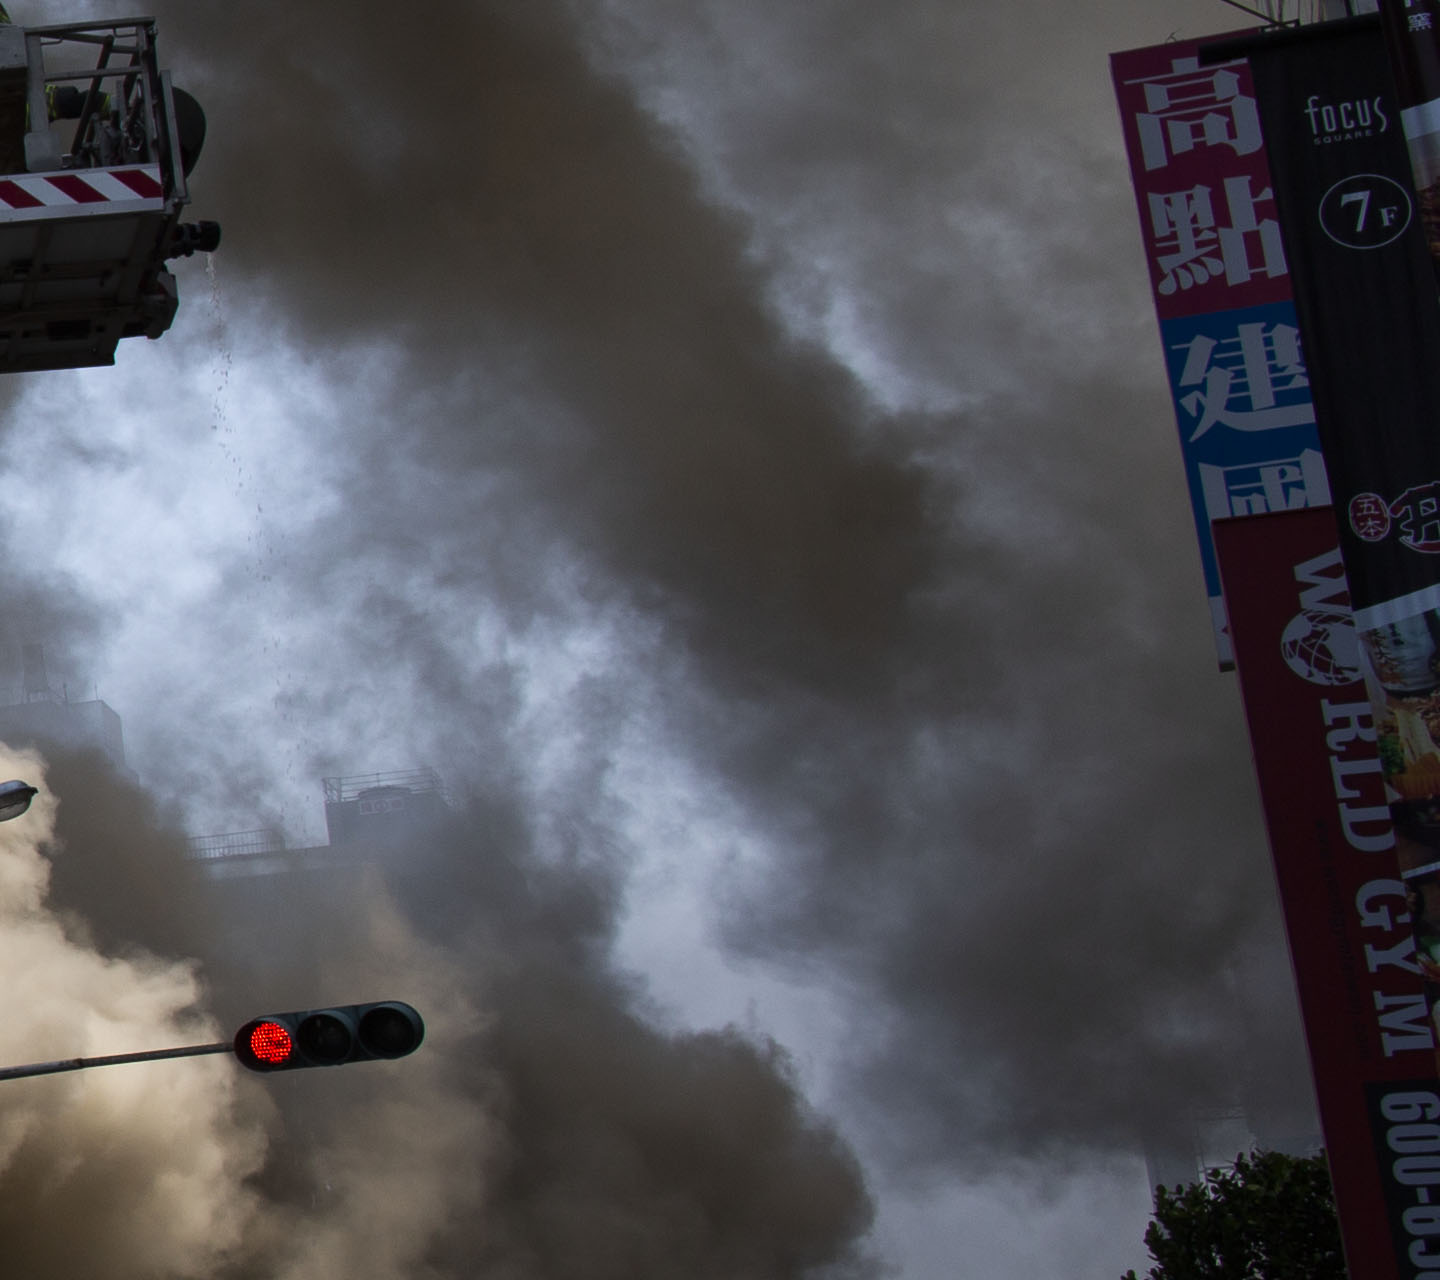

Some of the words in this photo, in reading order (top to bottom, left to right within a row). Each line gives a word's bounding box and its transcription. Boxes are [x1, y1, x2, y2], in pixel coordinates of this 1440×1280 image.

[1303, 95, 1389, 140] focus
[1313, 129, 1375, 145] SQUARE
[1355, 877, 1437, 1060] GYM
